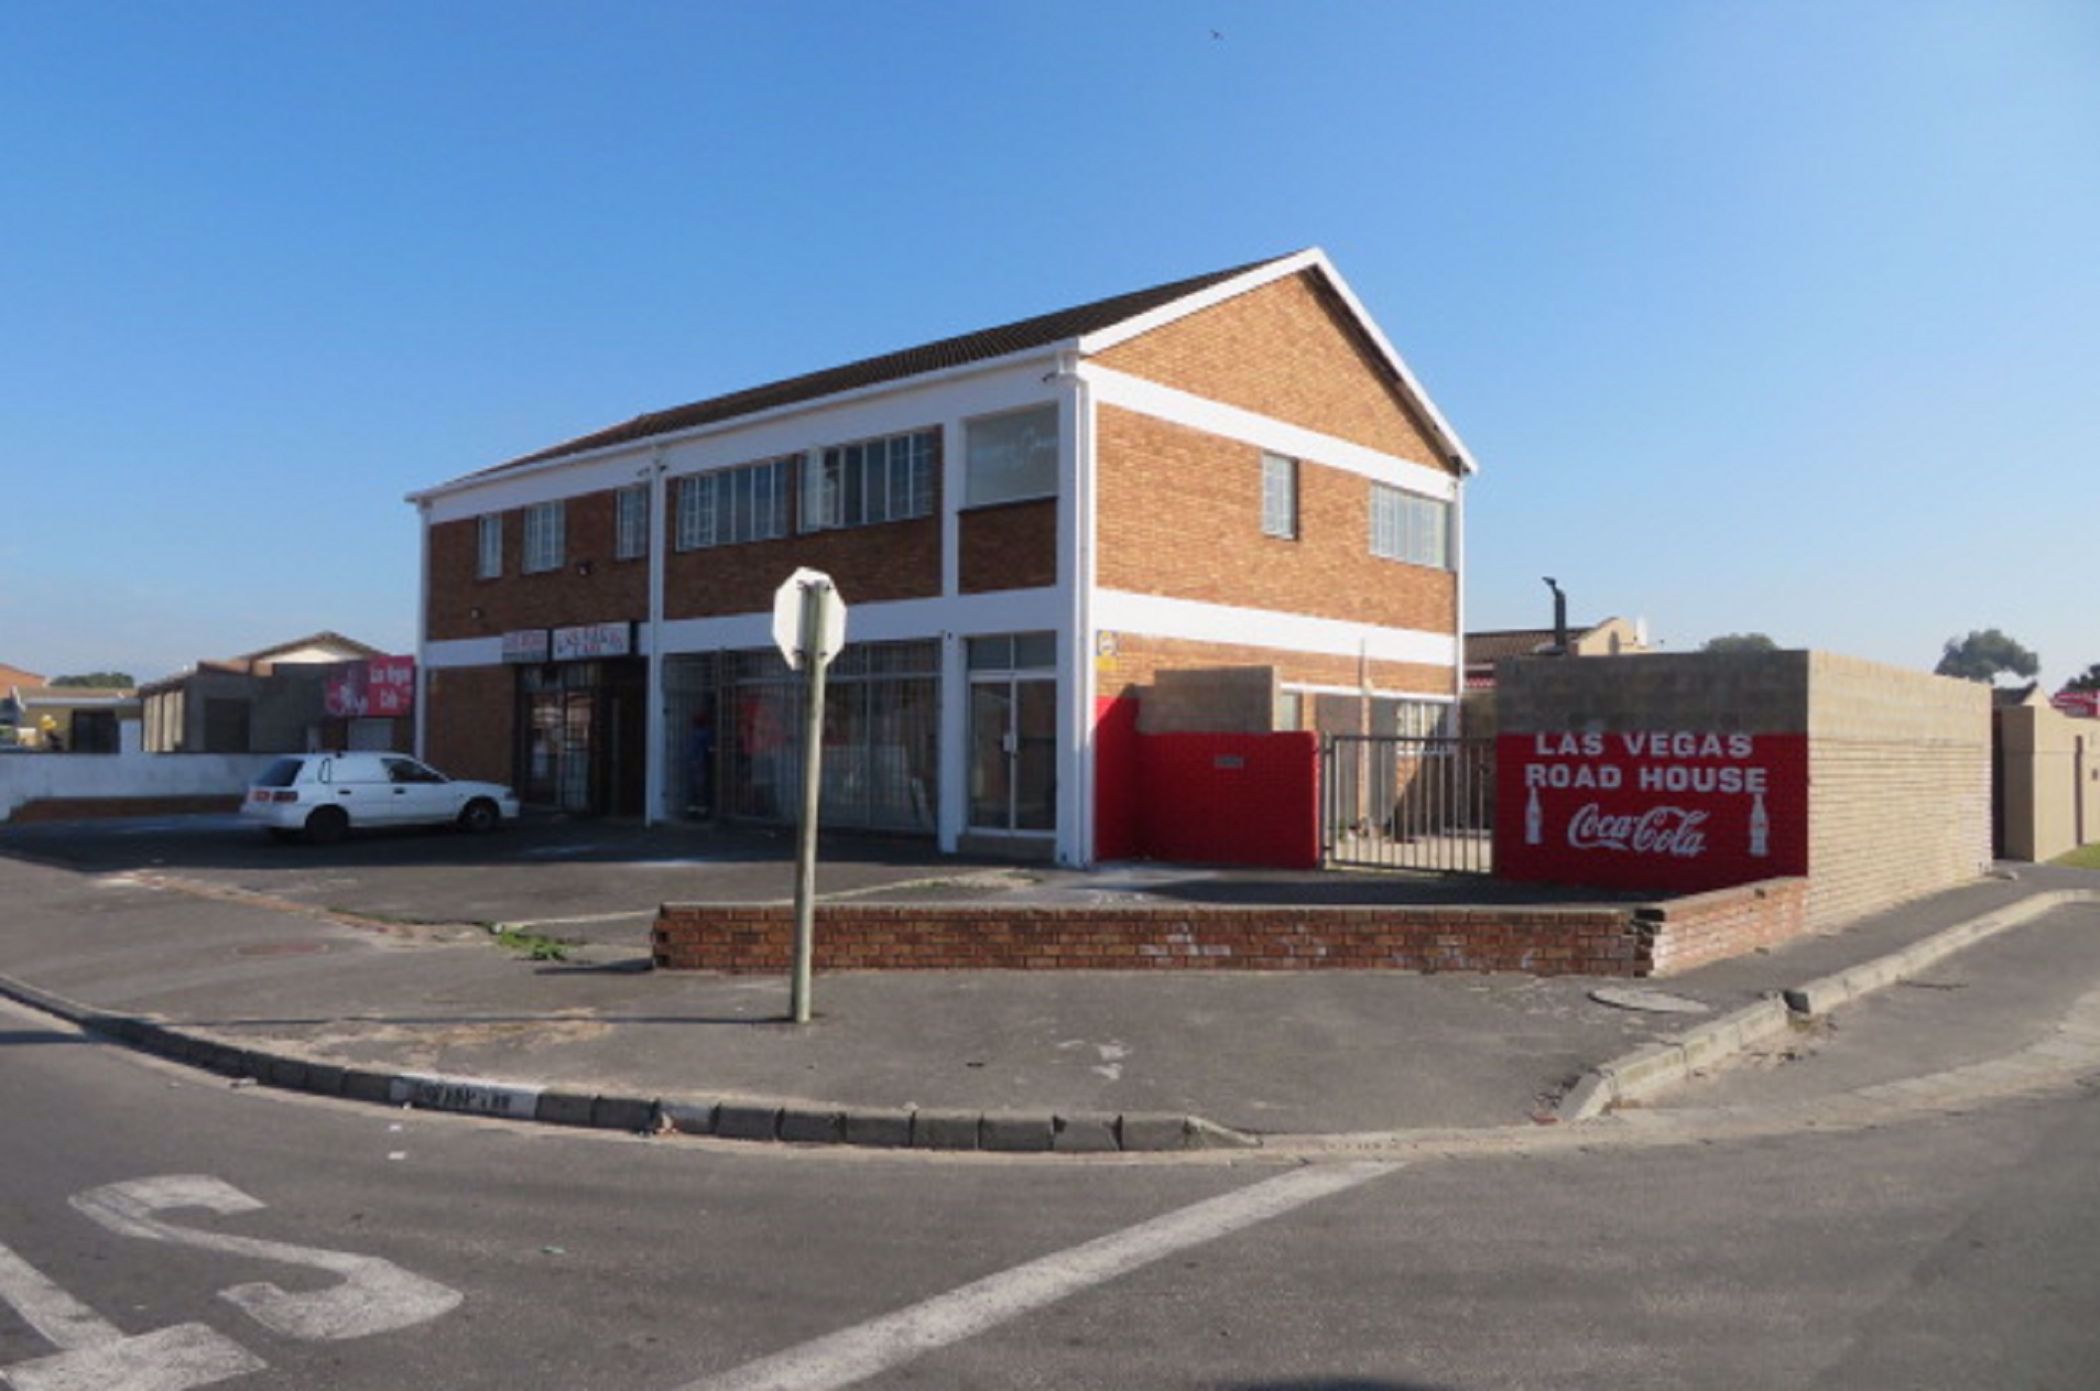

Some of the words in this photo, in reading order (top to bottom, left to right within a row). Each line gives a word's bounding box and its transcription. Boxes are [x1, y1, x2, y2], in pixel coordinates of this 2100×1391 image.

[1535, 731, 1604, 756] LAS
[1622, 731, 1753, 758] VEGAS
[1525, 763, 1622, 788] ROAD
[1639, 766, 1768, 794] HOUSE
[1567, 803, 1710, 856] Coca-Cola
